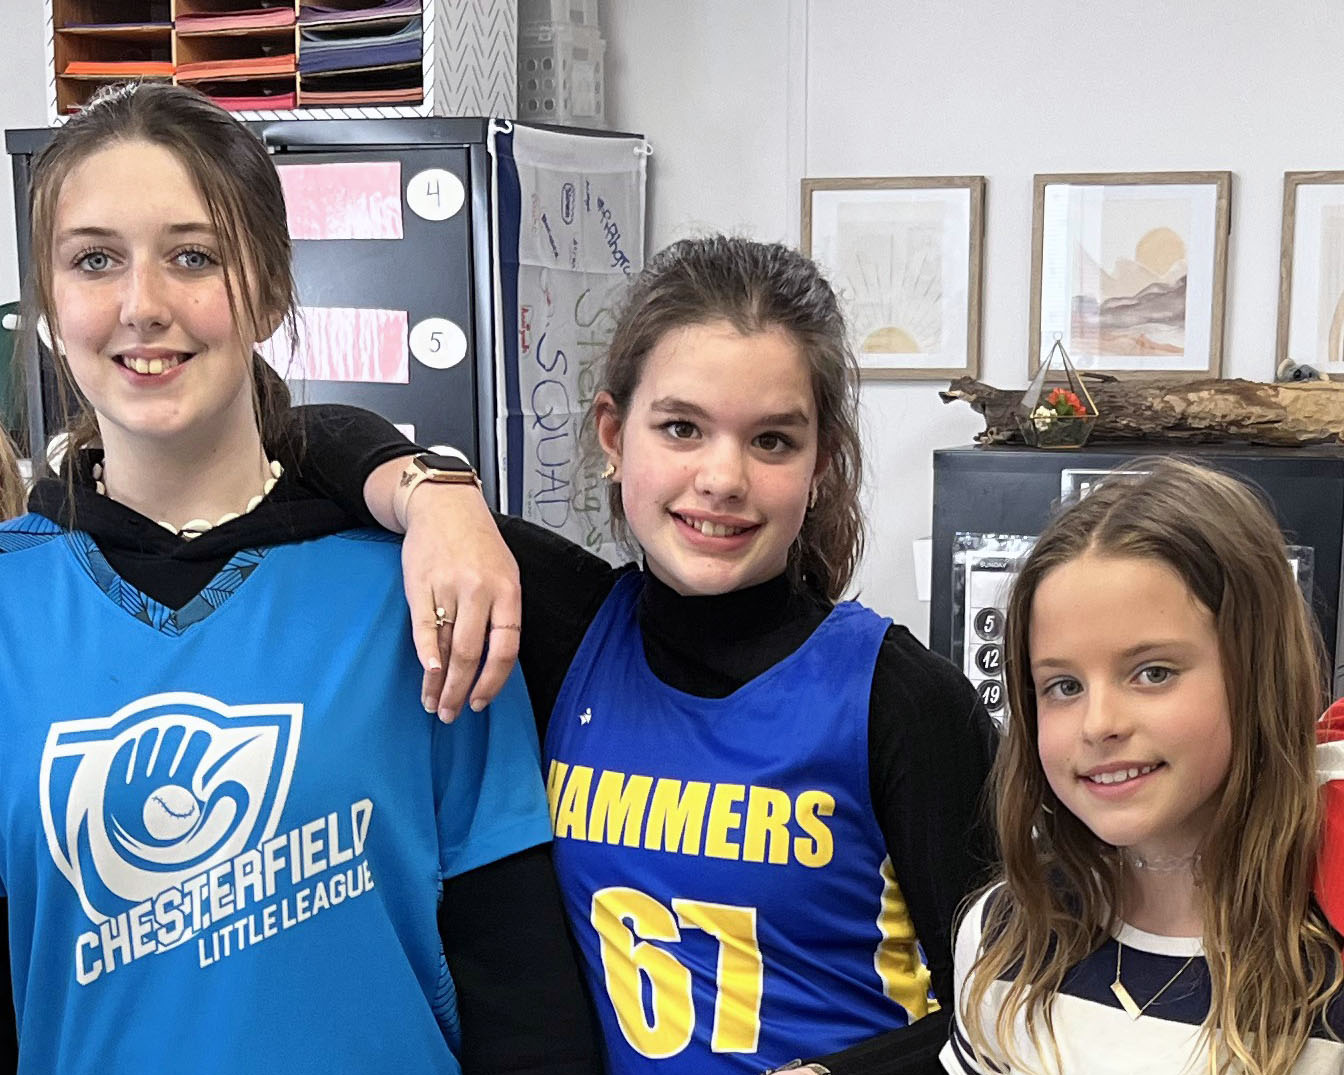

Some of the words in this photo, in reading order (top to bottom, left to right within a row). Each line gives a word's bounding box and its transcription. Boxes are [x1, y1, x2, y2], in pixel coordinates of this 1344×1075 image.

[425, 180, 441, 208] 4
[429, 331, 444, 354] 5
[532, 332, 572, 529] SQUAD
[983, 614, 996, 633] 5
[982, 648, 999, 669] 12
[981, 685, 1001, 705] 19
[74, 797, 375, 987] CHESTERFIELD
[197, 898, 279, 970] LITTLE
[281, 859, 376, 931] LEAGUE
[589, 885, 765, 1060] 67
